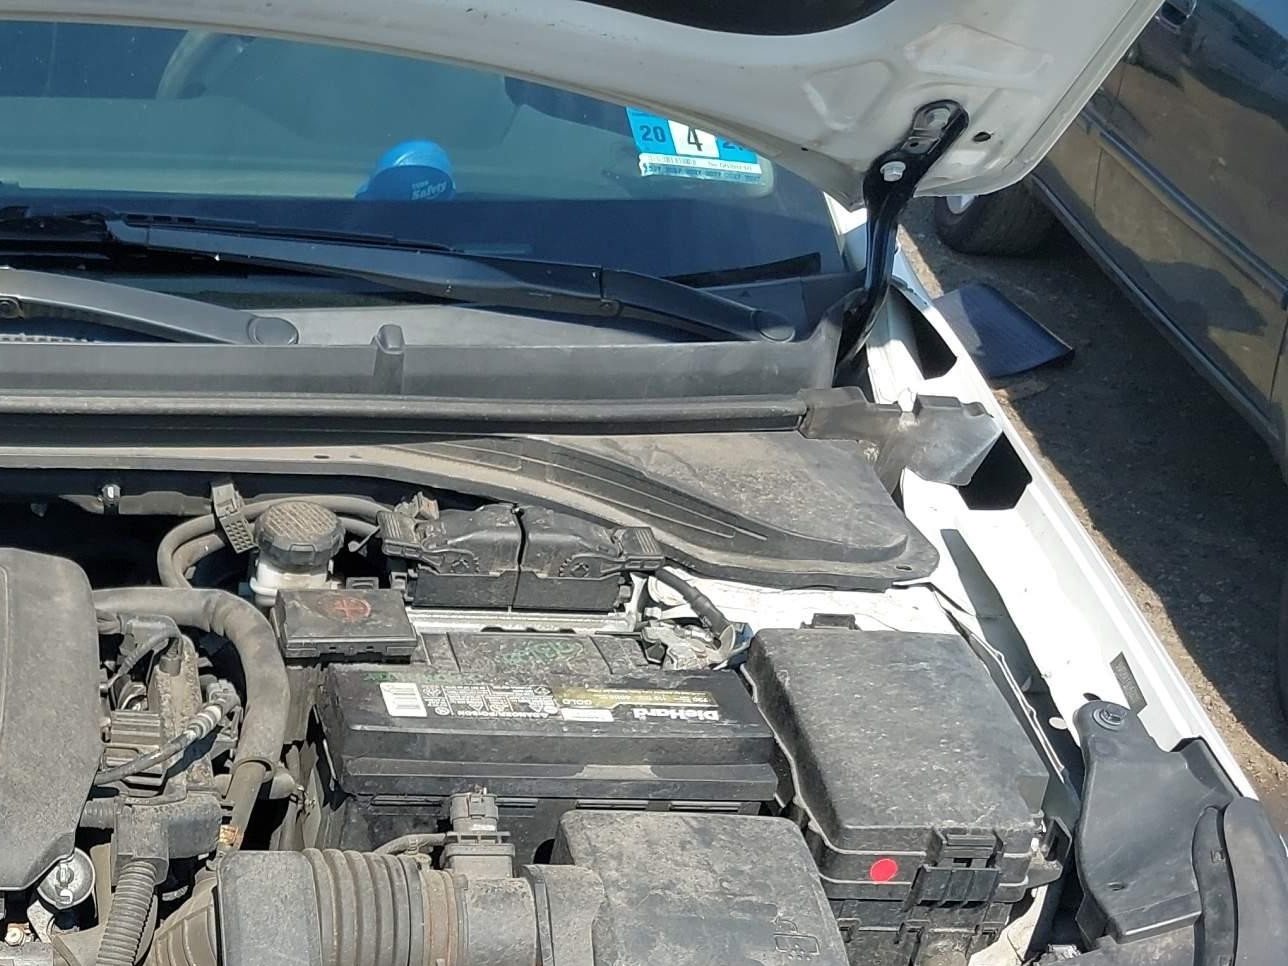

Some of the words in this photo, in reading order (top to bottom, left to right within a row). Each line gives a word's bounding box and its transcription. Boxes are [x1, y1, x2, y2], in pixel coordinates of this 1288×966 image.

[639, 125, 666, 143] 20
[687, 127, 703, 152] 4
[632, 707, 720, 721] DieHard
